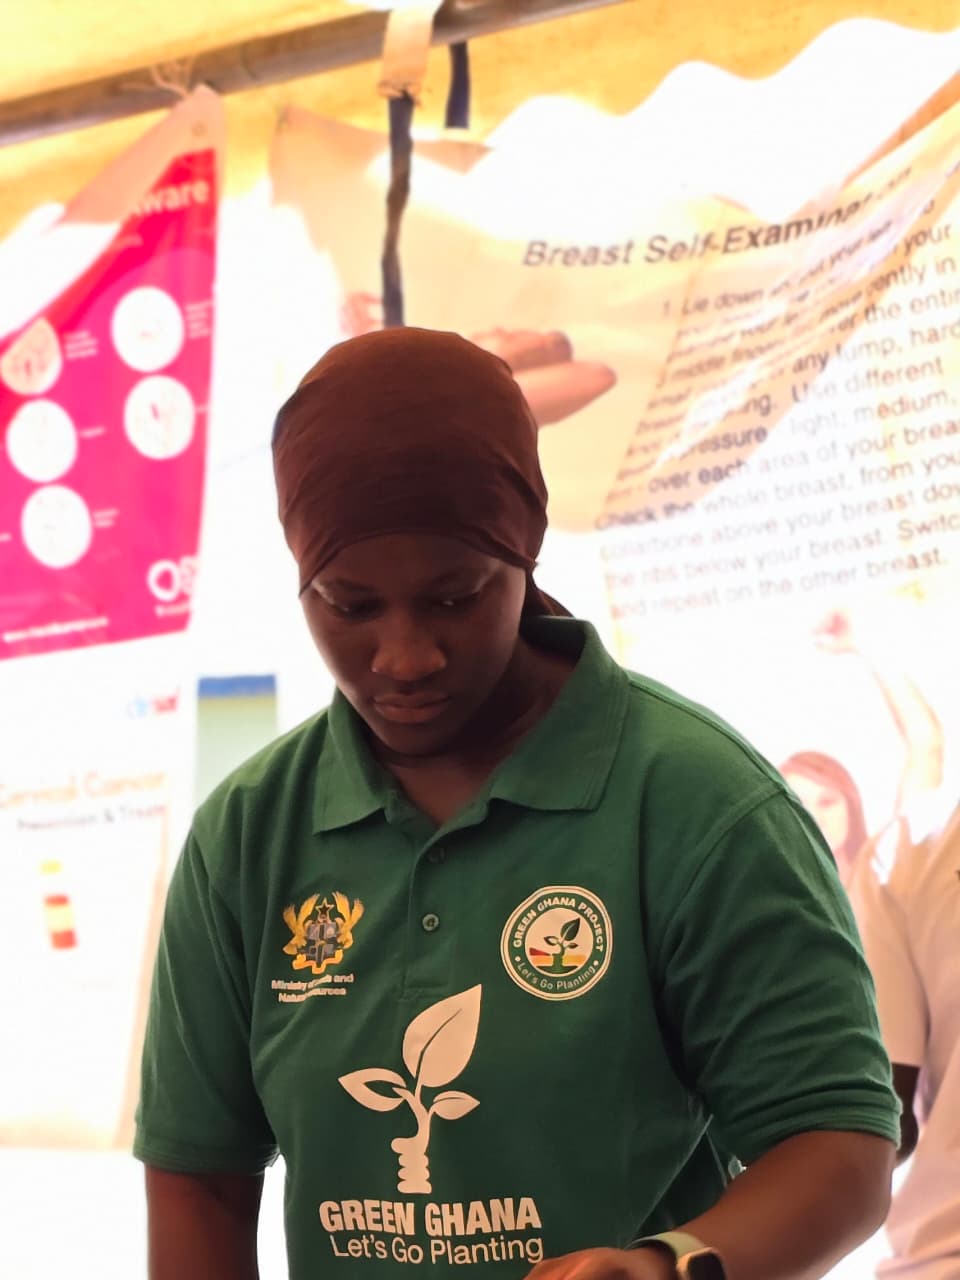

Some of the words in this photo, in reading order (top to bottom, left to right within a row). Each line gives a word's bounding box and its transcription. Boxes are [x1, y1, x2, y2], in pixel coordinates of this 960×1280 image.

[522, 238, 634, 267] Breast
[845, 432, 896, 460] your
[513, 909, 537, 949] GREEN
[537, 896, 576, 913] GHANA
[577, 901, 605, 953] PROJECT
[517, 962, 539, 984] Let's
[540, 979, 554, 990] Go
[556, 965, 596, 990] Planting
[319, 1199, 415, 1236] GREEN
[424, 1197, 542, 1237] GHANA
[329, 1233, 388, 1259] Let's
[391, 1236, 424, 1264] Go
[430, 1233, 544, 1265] Planting
